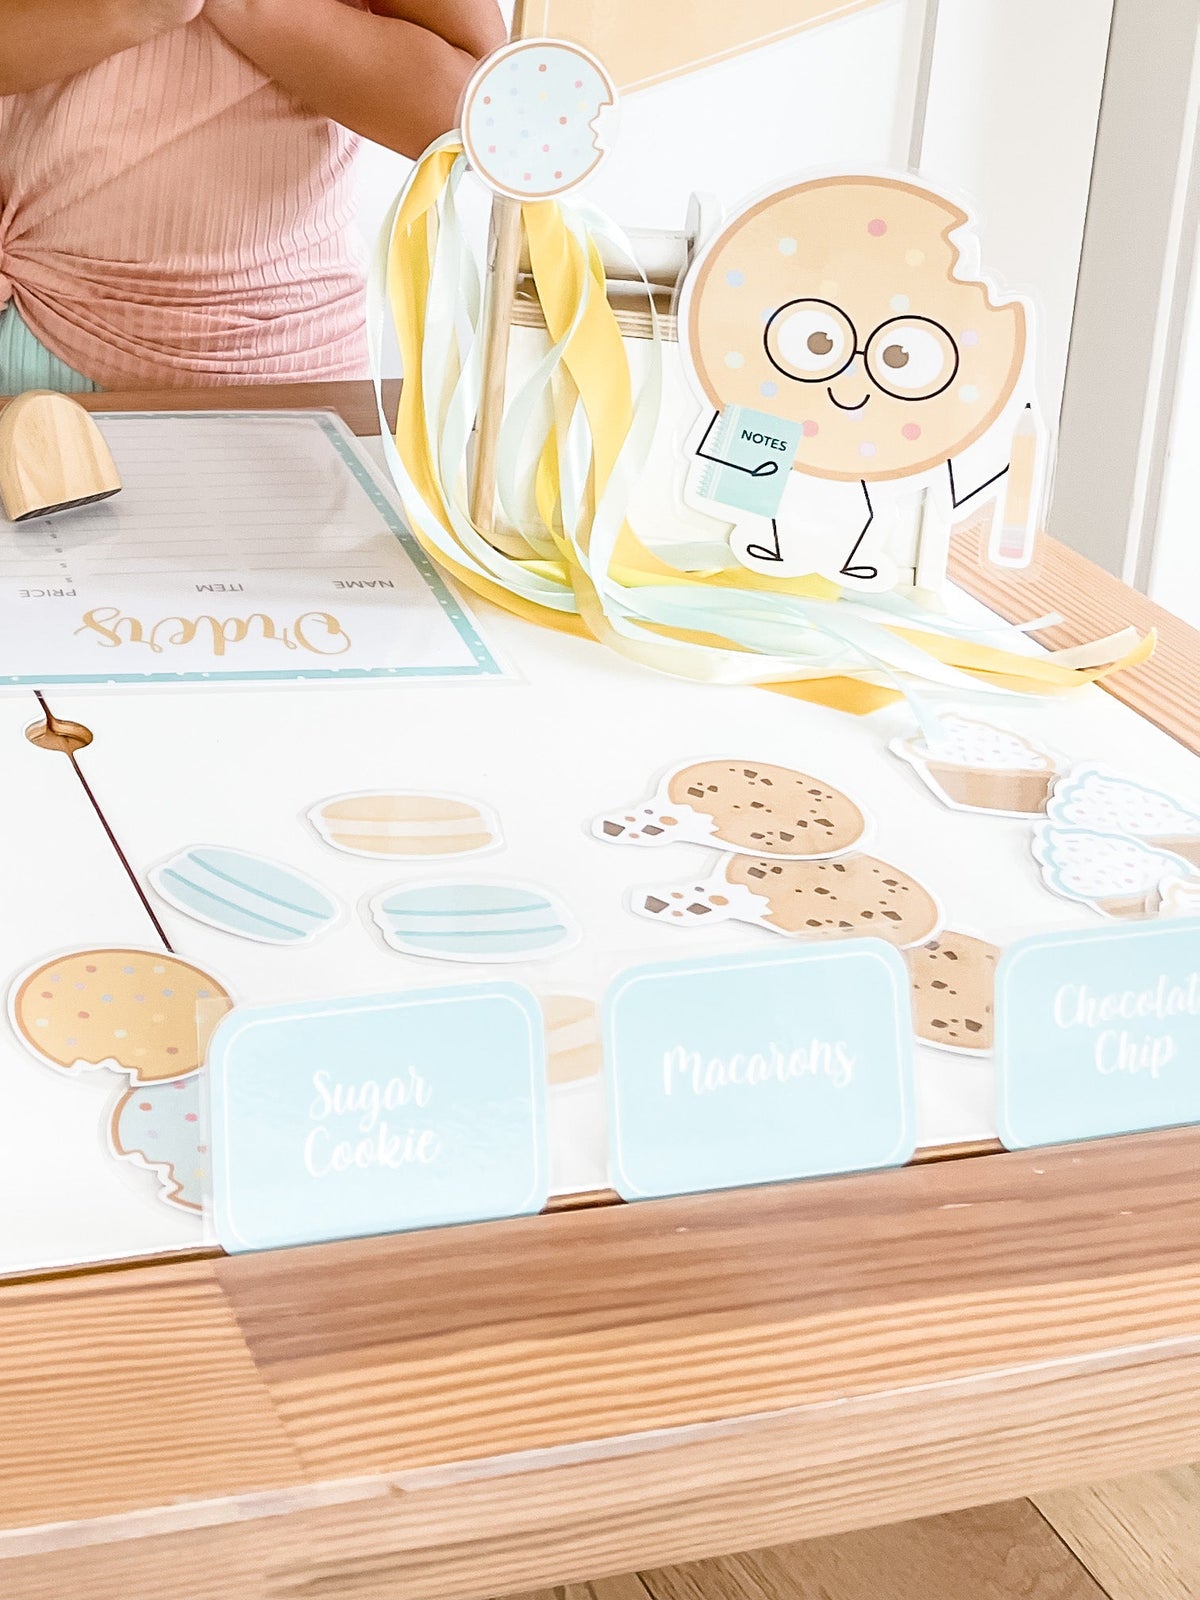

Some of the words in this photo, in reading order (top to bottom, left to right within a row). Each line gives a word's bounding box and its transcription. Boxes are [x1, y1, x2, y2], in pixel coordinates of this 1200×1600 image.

[741, 428, 788, 452] NOTES
[20, 588, 77, 598] PRICE
[195, 583, 244, 593] ITEM
[333, 580, 394, 589] NAME
[73, 606, 351, 656] Orders
[663, 1038, 856, 1096] Macarons
[1095, 1029, 1175, 1079] Chip
[309, 1065, 432, 1132] Sugar
[304, 1120, 442, 1178] Cookie
